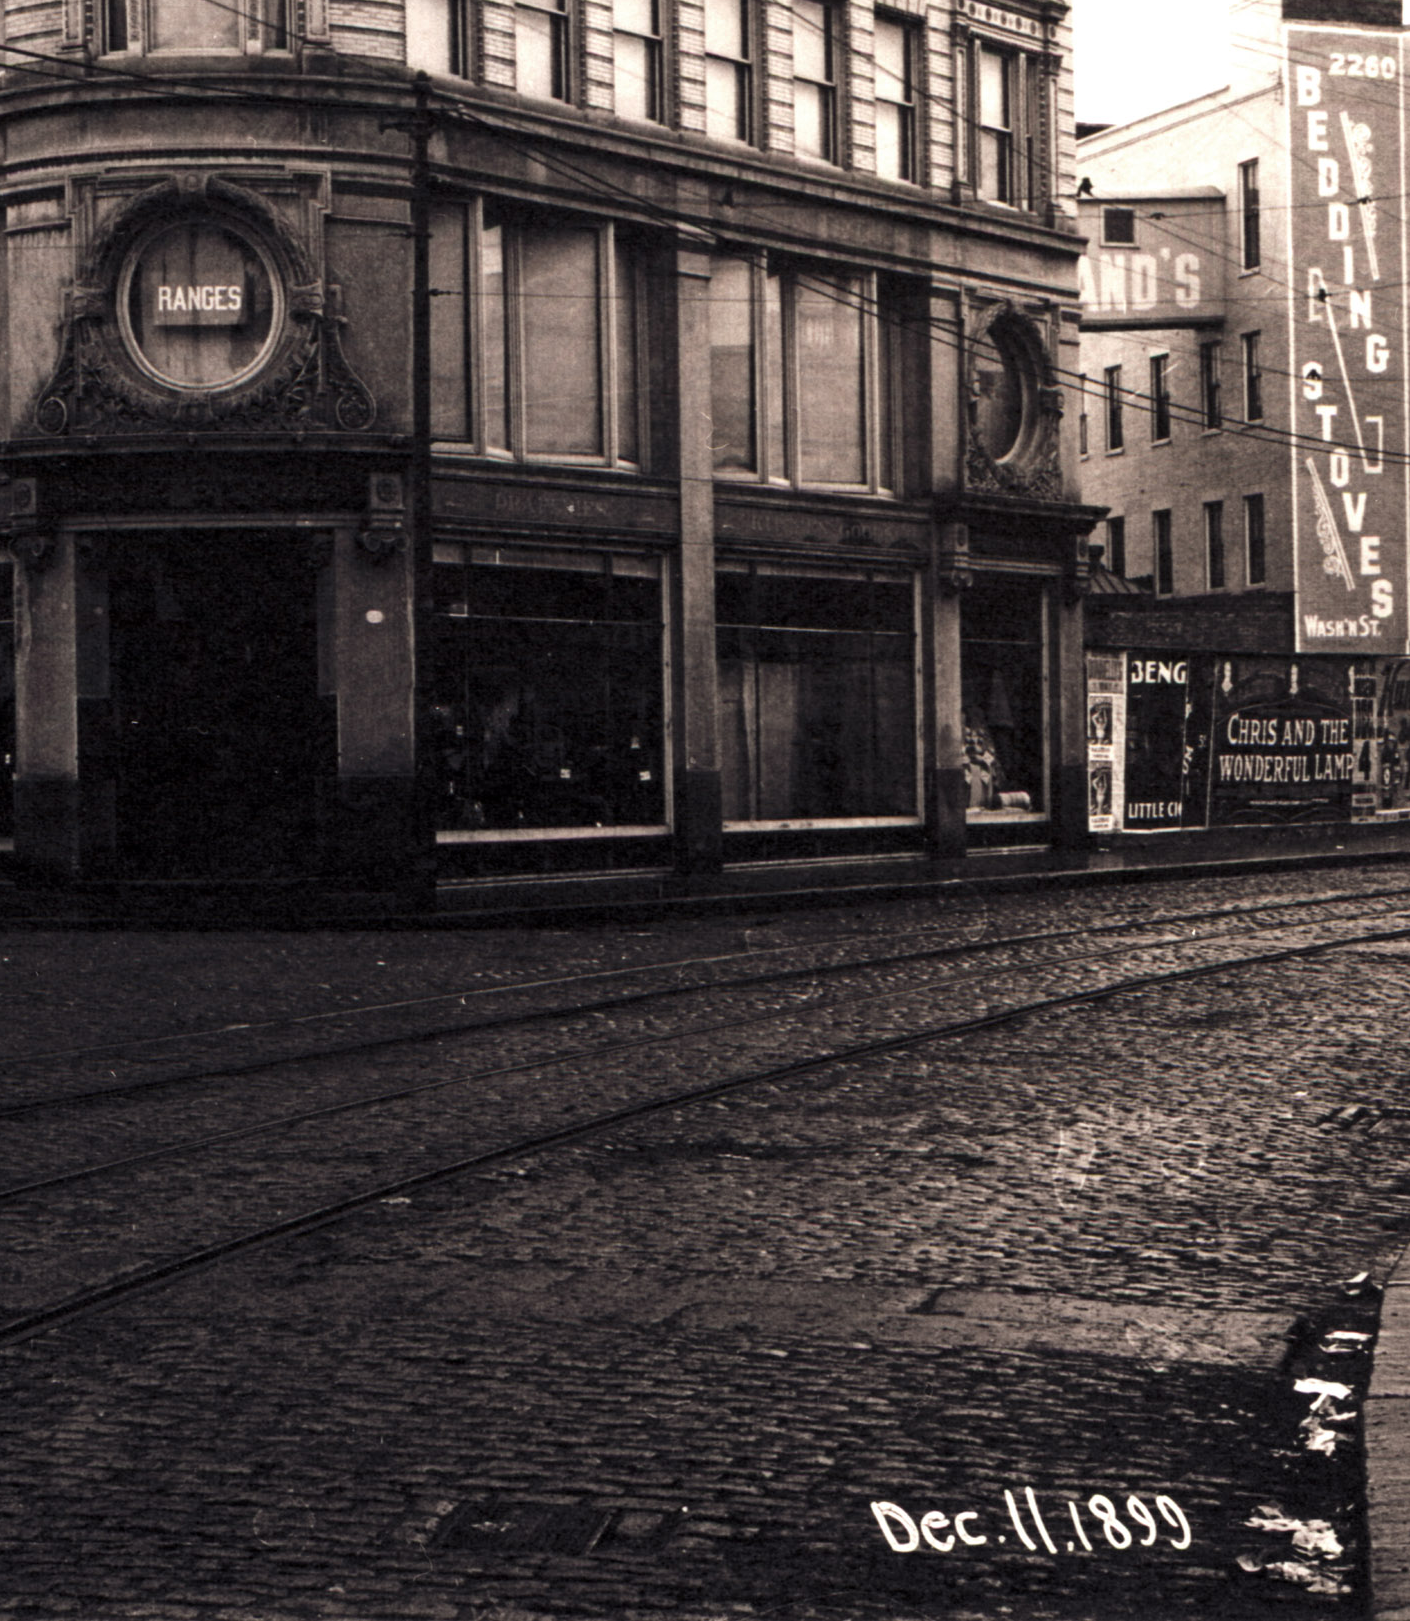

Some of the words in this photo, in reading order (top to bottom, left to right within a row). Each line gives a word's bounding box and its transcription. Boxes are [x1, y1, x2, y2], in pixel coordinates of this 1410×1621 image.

[1328, 52, 1397, 79] 2260
[1295, 65, 1390, 373] BEDDING
[158, 285, 243, 312] RANGES
[1302, 361, 1394, 619] STOVES
[1227, 713, 1279, 746] CHRIS
[1281, 718, 1316, 746] AND
[1320, 718, 1350, 745] THE
[1219, 754, 1311, 783] WONDERFUL
[1314, 753, 1356, 781] LAMP
[1128, 801, 1165, 819] LITTLE
